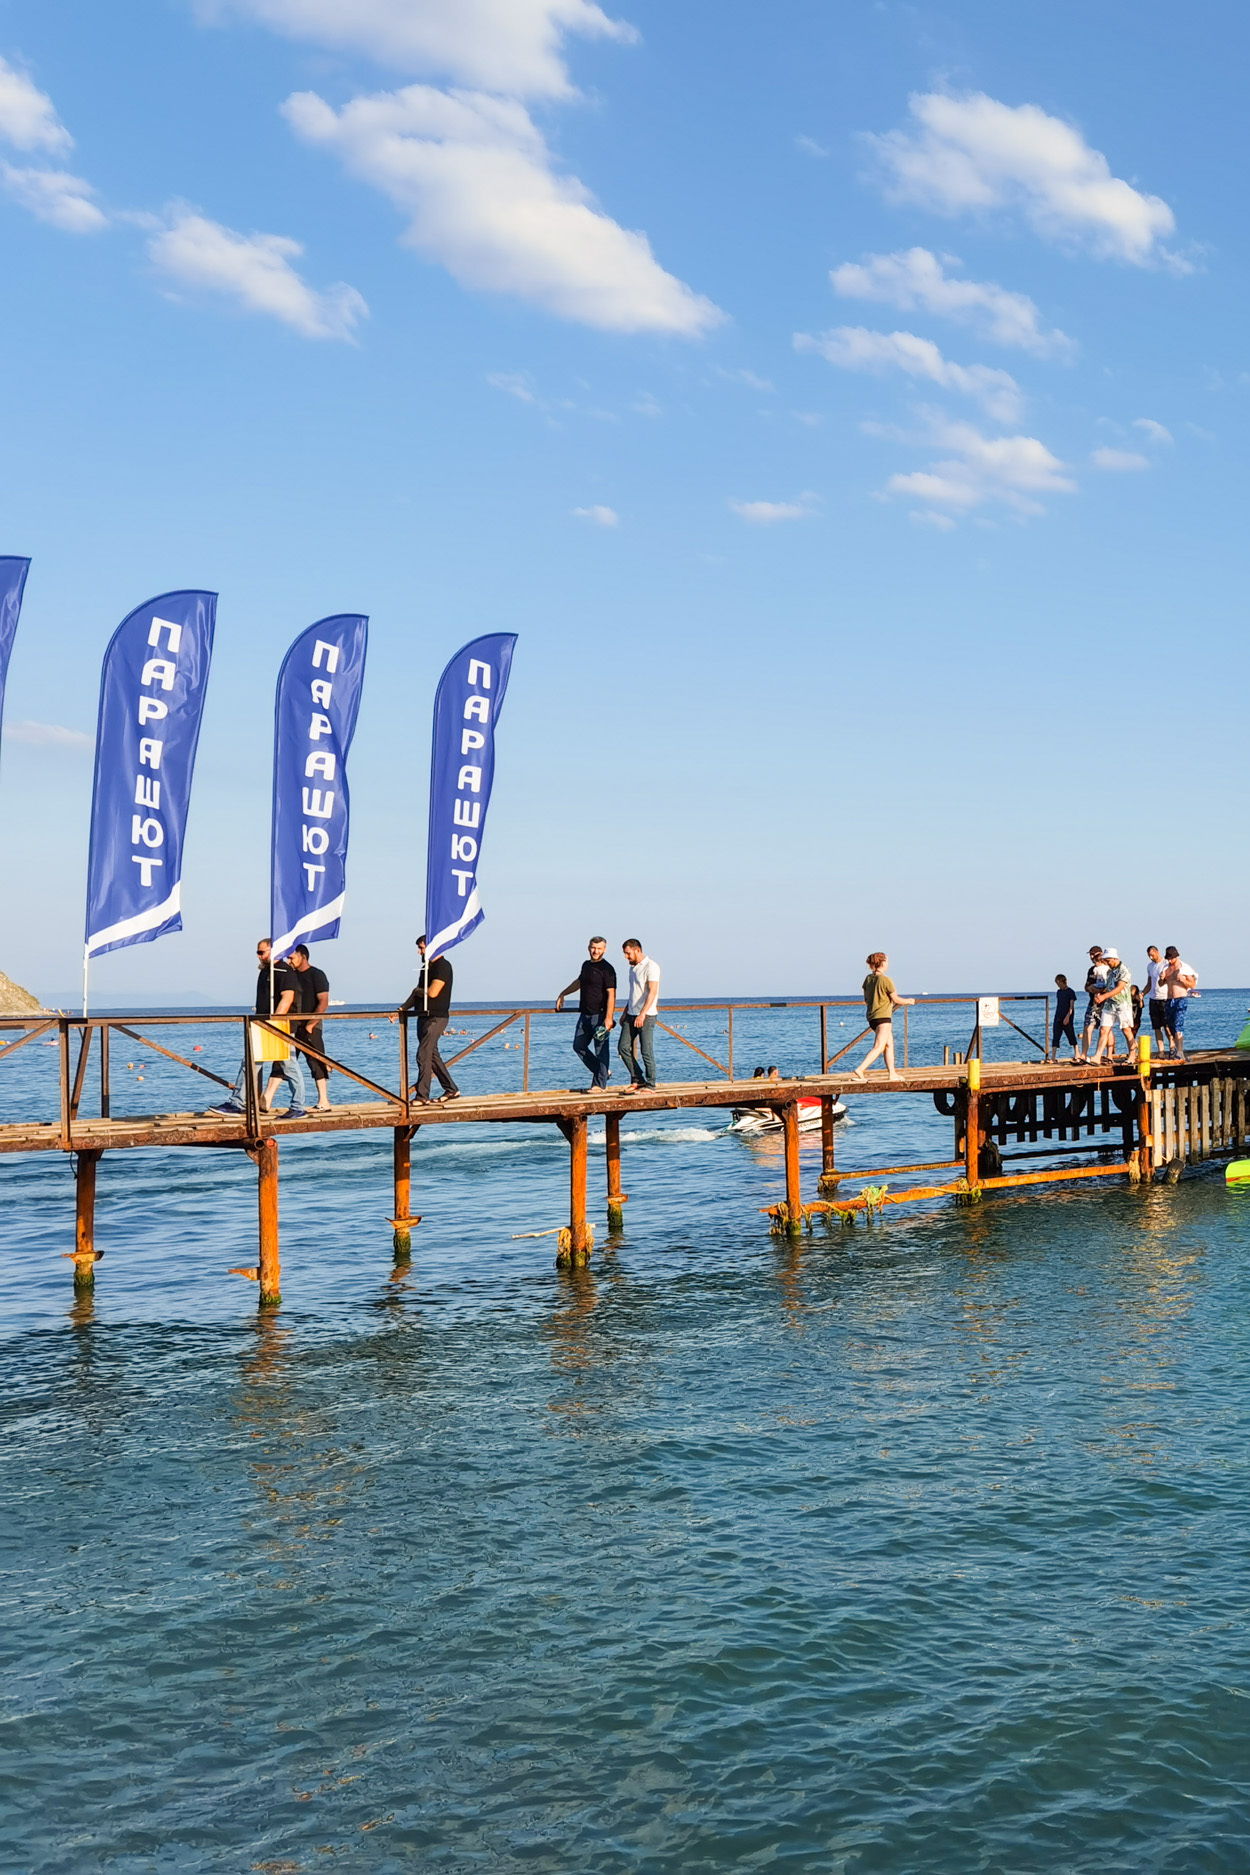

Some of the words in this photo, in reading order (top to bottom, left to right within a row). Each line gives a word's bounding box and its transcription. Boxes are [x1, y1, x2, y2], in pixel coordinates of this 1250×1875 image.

[131, 616, 182, 887] ПАРАШЮТ
[302, 640, 340, 892] ПАРАШЮТ
[451, 658, 491, 897] ПАРАШЮТ
